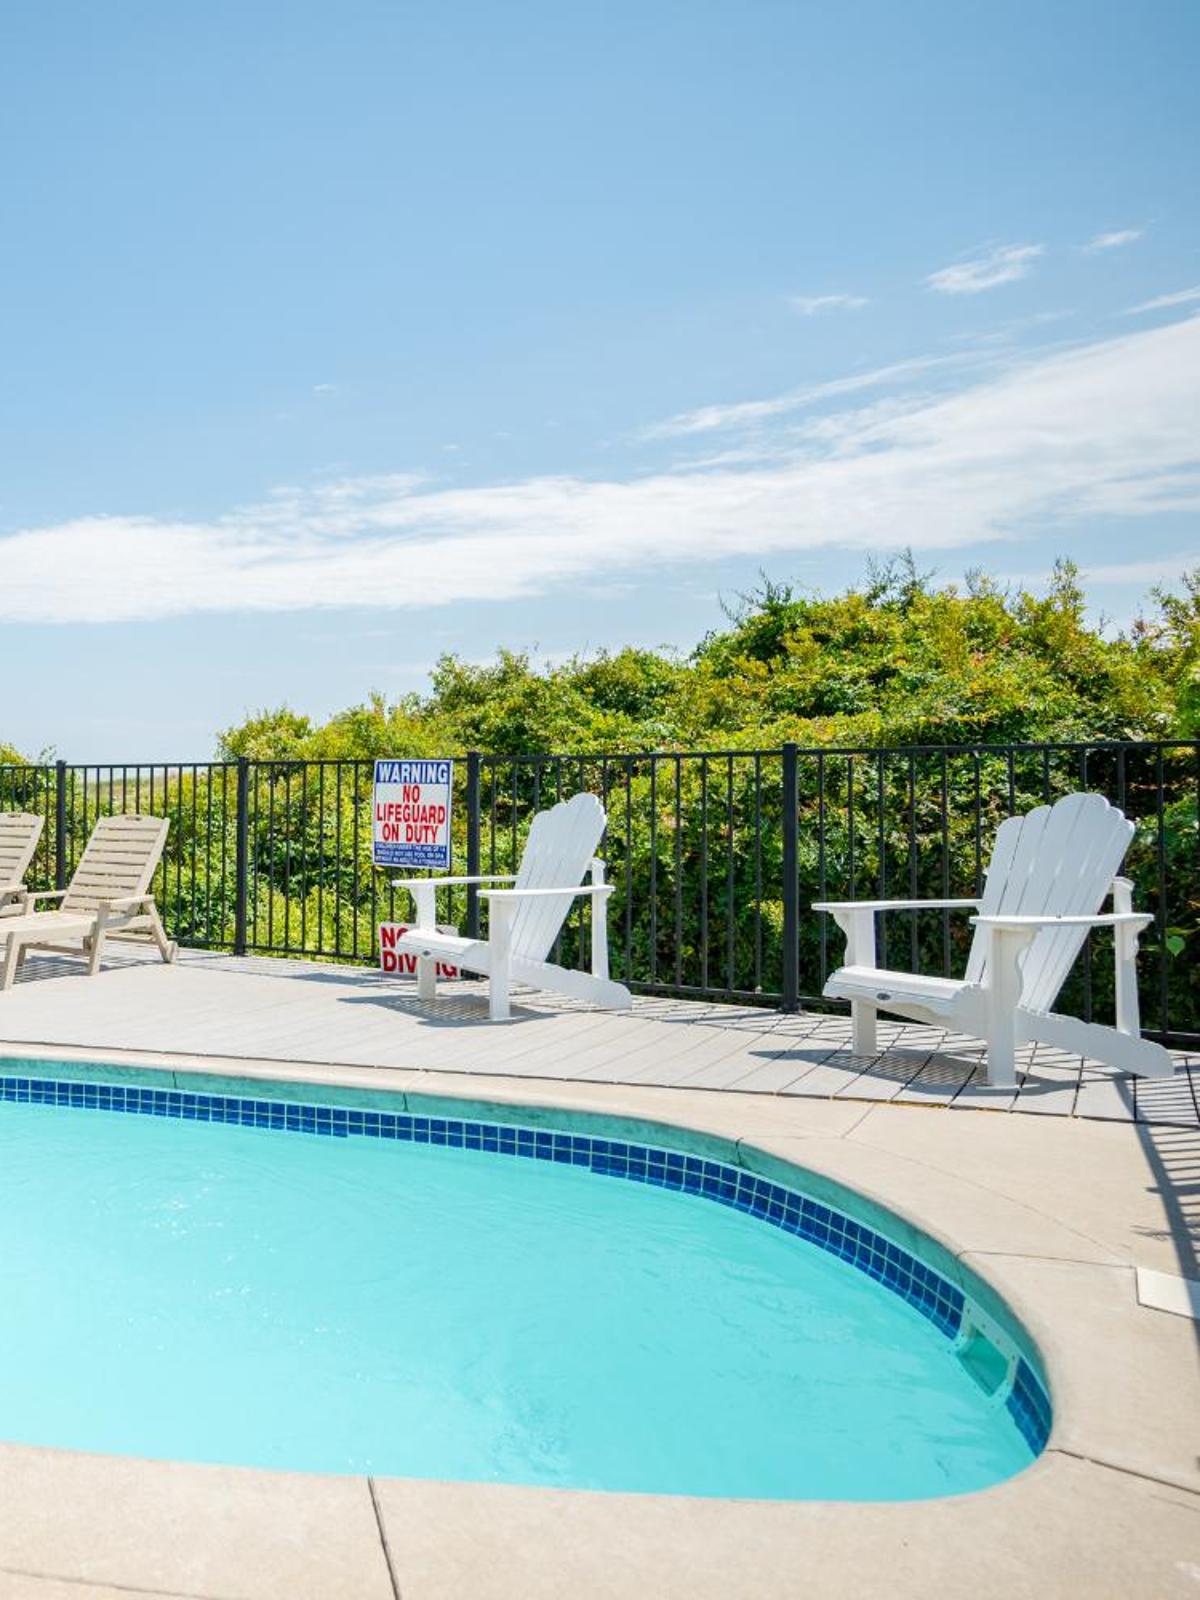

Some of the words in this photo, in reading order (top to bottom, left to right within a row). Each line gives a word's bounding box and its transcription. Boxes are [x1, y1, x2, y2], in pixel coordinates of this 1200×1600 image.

[379, 763, 448, 783] WARNING
[403, 785, 420, 803] NO
[377, 803, 445, 824] LIFEGUARD
[382, 823, 399, 841] ON
[406, 825, 438, 843] DUTY
[382, 950, 457, 977] DIVG
